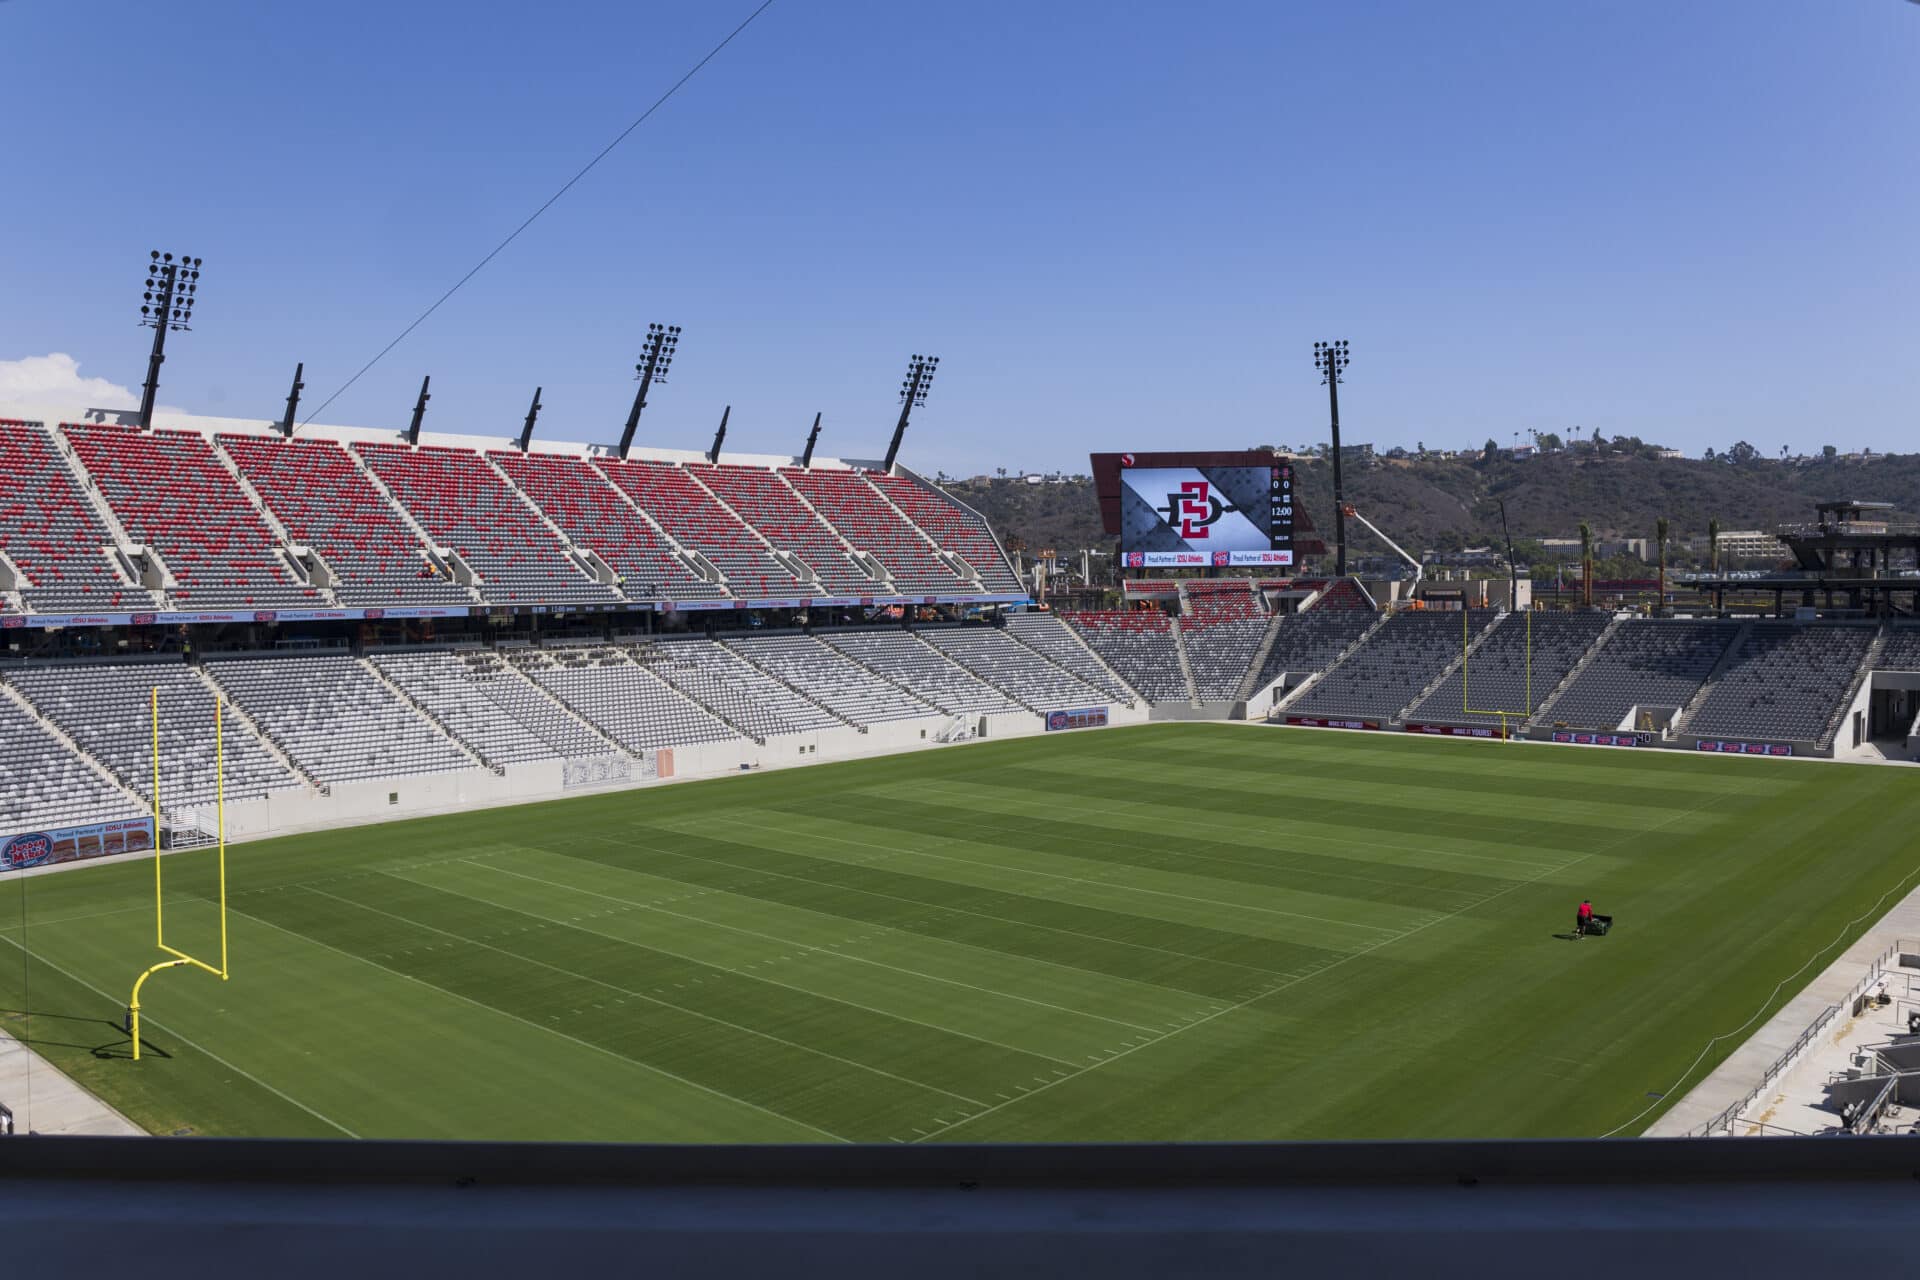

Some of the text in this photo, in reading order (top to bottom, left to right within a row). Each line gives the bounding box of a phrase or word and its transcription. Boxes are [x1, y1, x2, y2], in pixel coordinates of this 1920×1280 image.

[1273, 481, 1289, 489] 0 0
[1272, 507, 1292, 516] 12:00
[1471, 728, 1492, 737] YOURS!
[56, 830, 74, 839] Proud
[75, 827, 96, 835] Partner
[105, 823, 121, 832] SDSU
[123, 821, 148, 829] Athletics
[9, 838, 46, 854] Jersey
